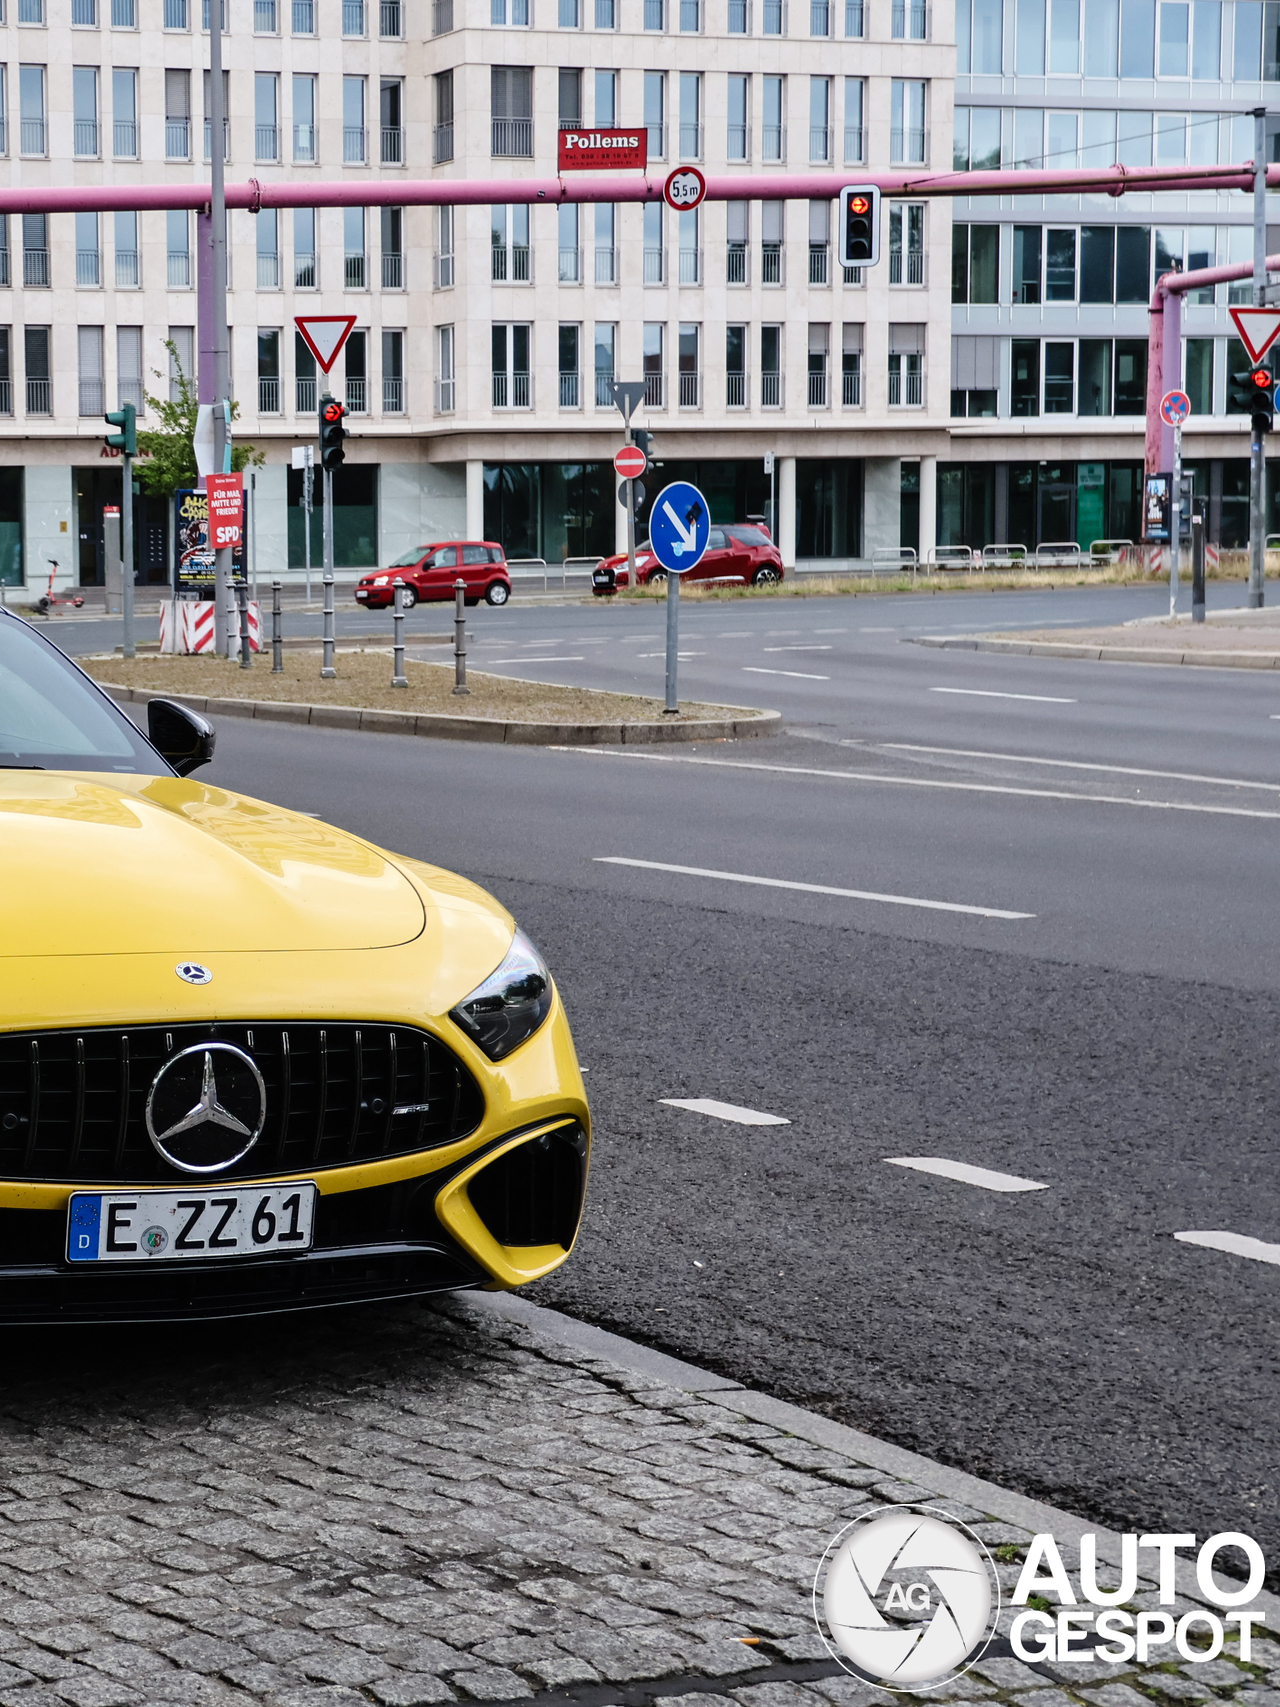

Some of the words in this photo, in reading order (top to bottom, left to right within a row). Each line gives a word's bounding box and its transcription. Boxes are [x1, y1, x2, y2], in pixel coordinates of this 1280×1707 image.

[565, 134, 639, 149] Pollems
[672, 181, 688, 197] 5,5
[689, 186, 698, 196] m
[213, 489, 226, 499] FÜR
[211, 499, 230, 508] MITTE
[230, 498, 241, 507] UND
[216, 507, 238, 516] FRIEDEN
[216, 526, 239, 543] SPD
[106, 1201, 138, 1252] E
[174, 1197, 238, 1250] ZZ
[251, 1193, 305, 1244] 61
[78, 1234, 90, 1249] D
